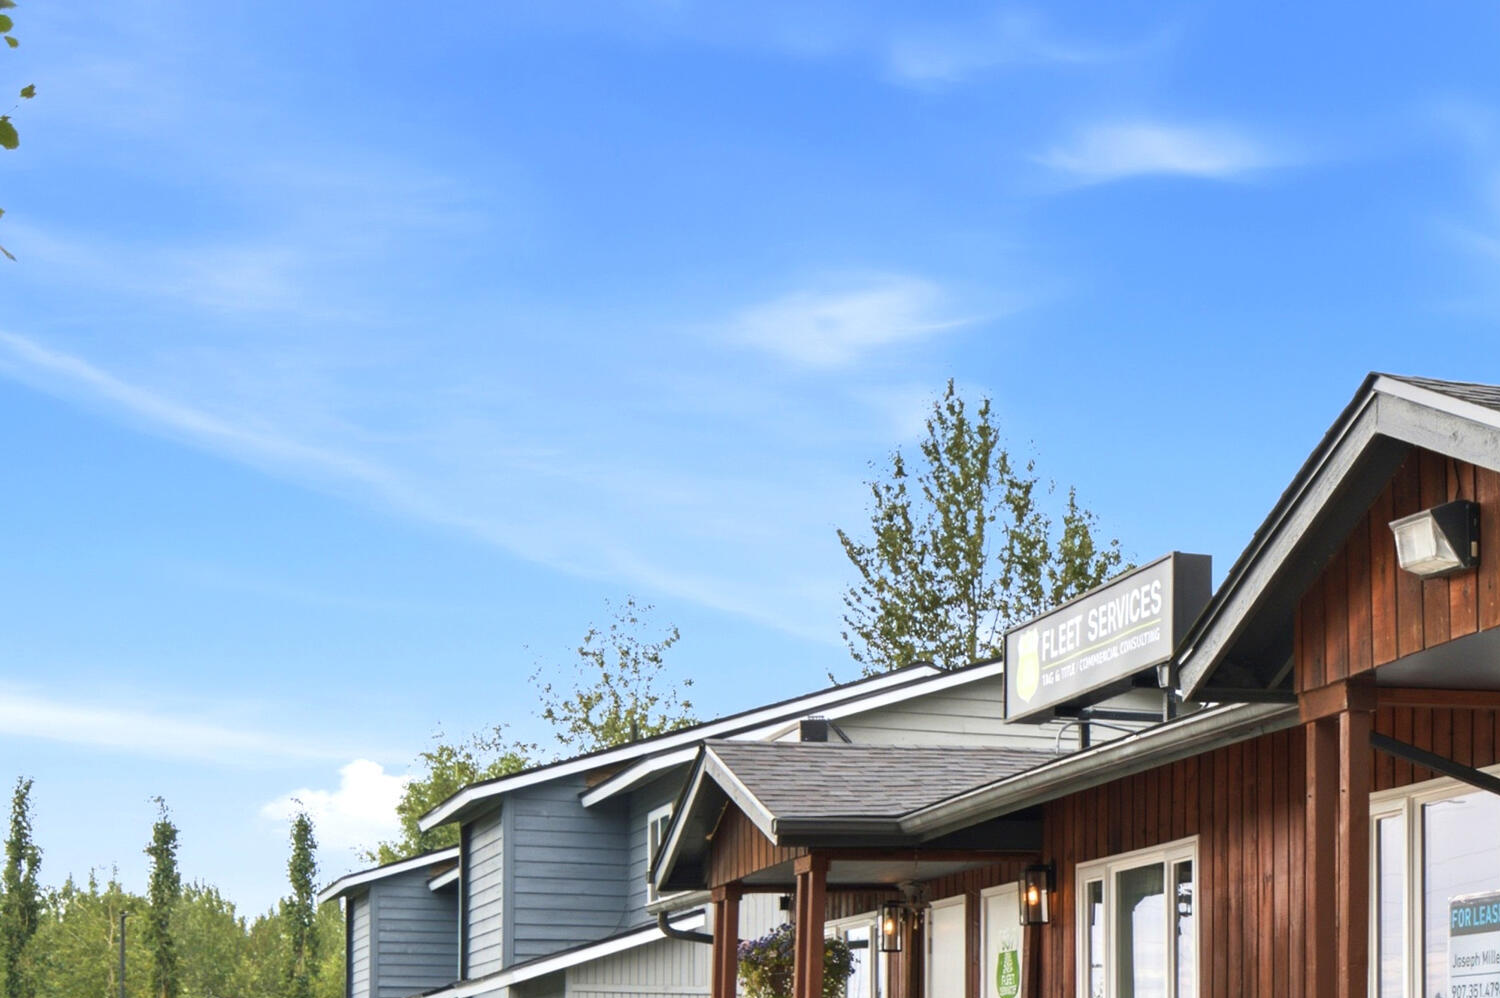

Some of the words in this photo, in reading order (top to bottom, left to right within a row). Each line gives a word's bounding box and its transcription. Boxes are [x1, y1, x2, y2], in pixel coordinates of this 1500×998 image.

[1041, 614, 1084, 662] FLEET
[1087, 579, 1162, 642] SERVICES
[1119, 627, 1160, 656] CONSULTING
[1451, 907, 1471, 928] FOR
[1452, 951, 1480, 969] Joseph
